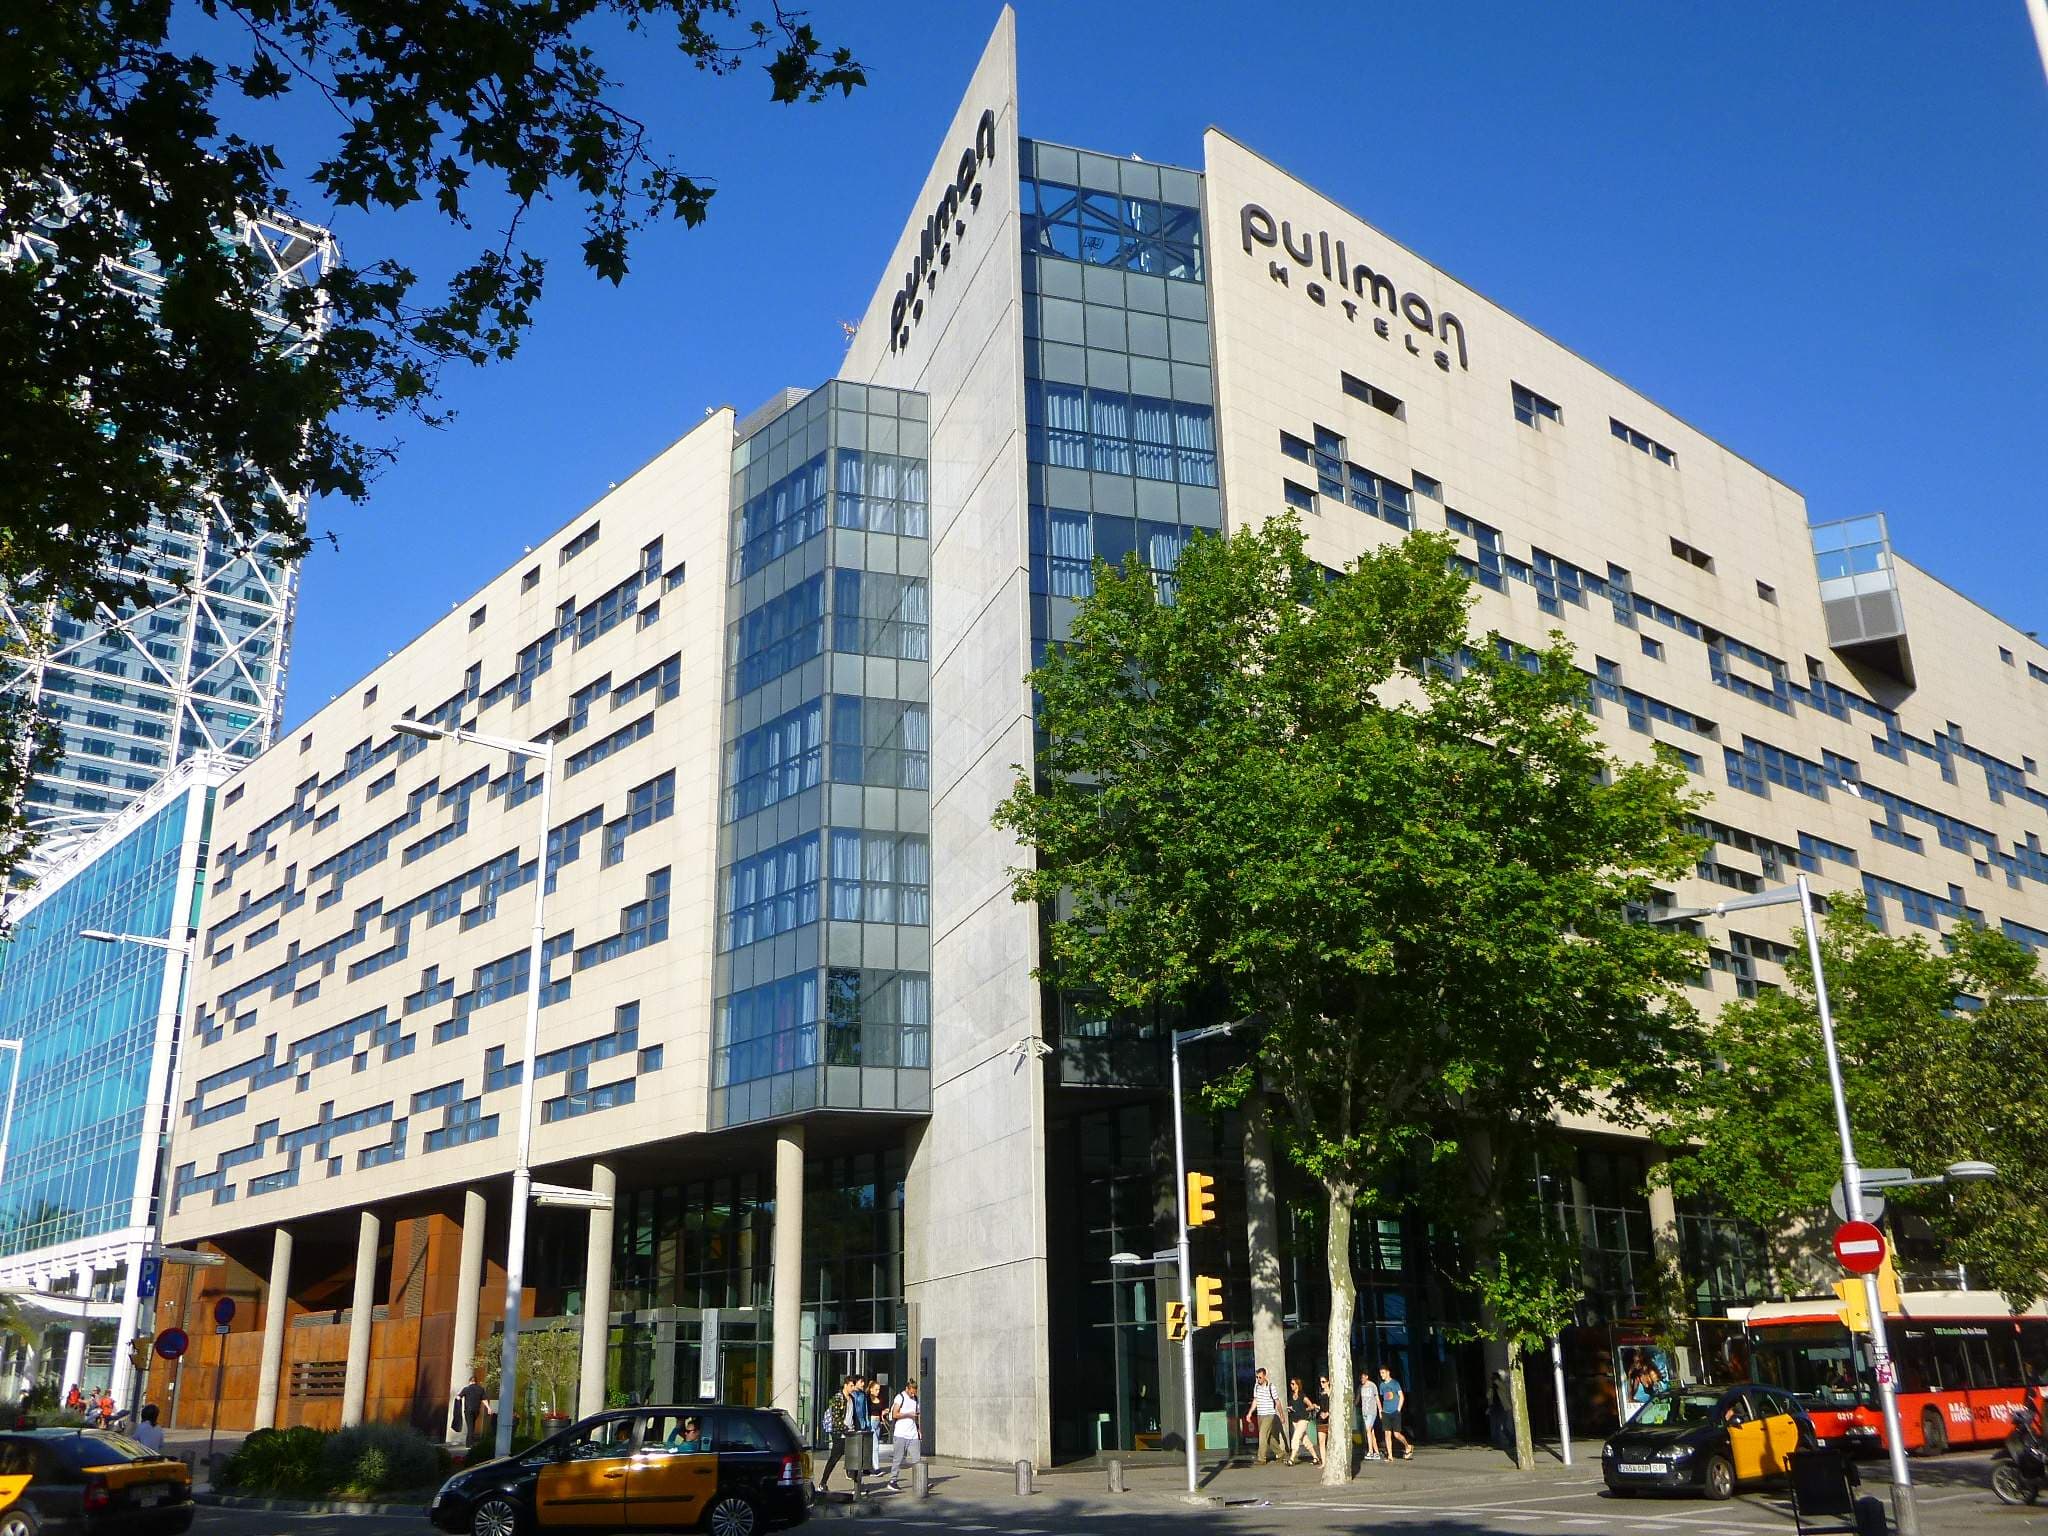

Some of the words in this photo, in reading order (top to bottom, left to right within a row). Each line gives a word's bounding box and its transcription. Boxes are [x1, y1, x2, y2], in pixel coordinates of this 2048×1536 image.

[890, 109, 994, 354] pullman
[1240, 203, 1469, 371] pullman
[1269, 261, 1450, 372] HOTELS
